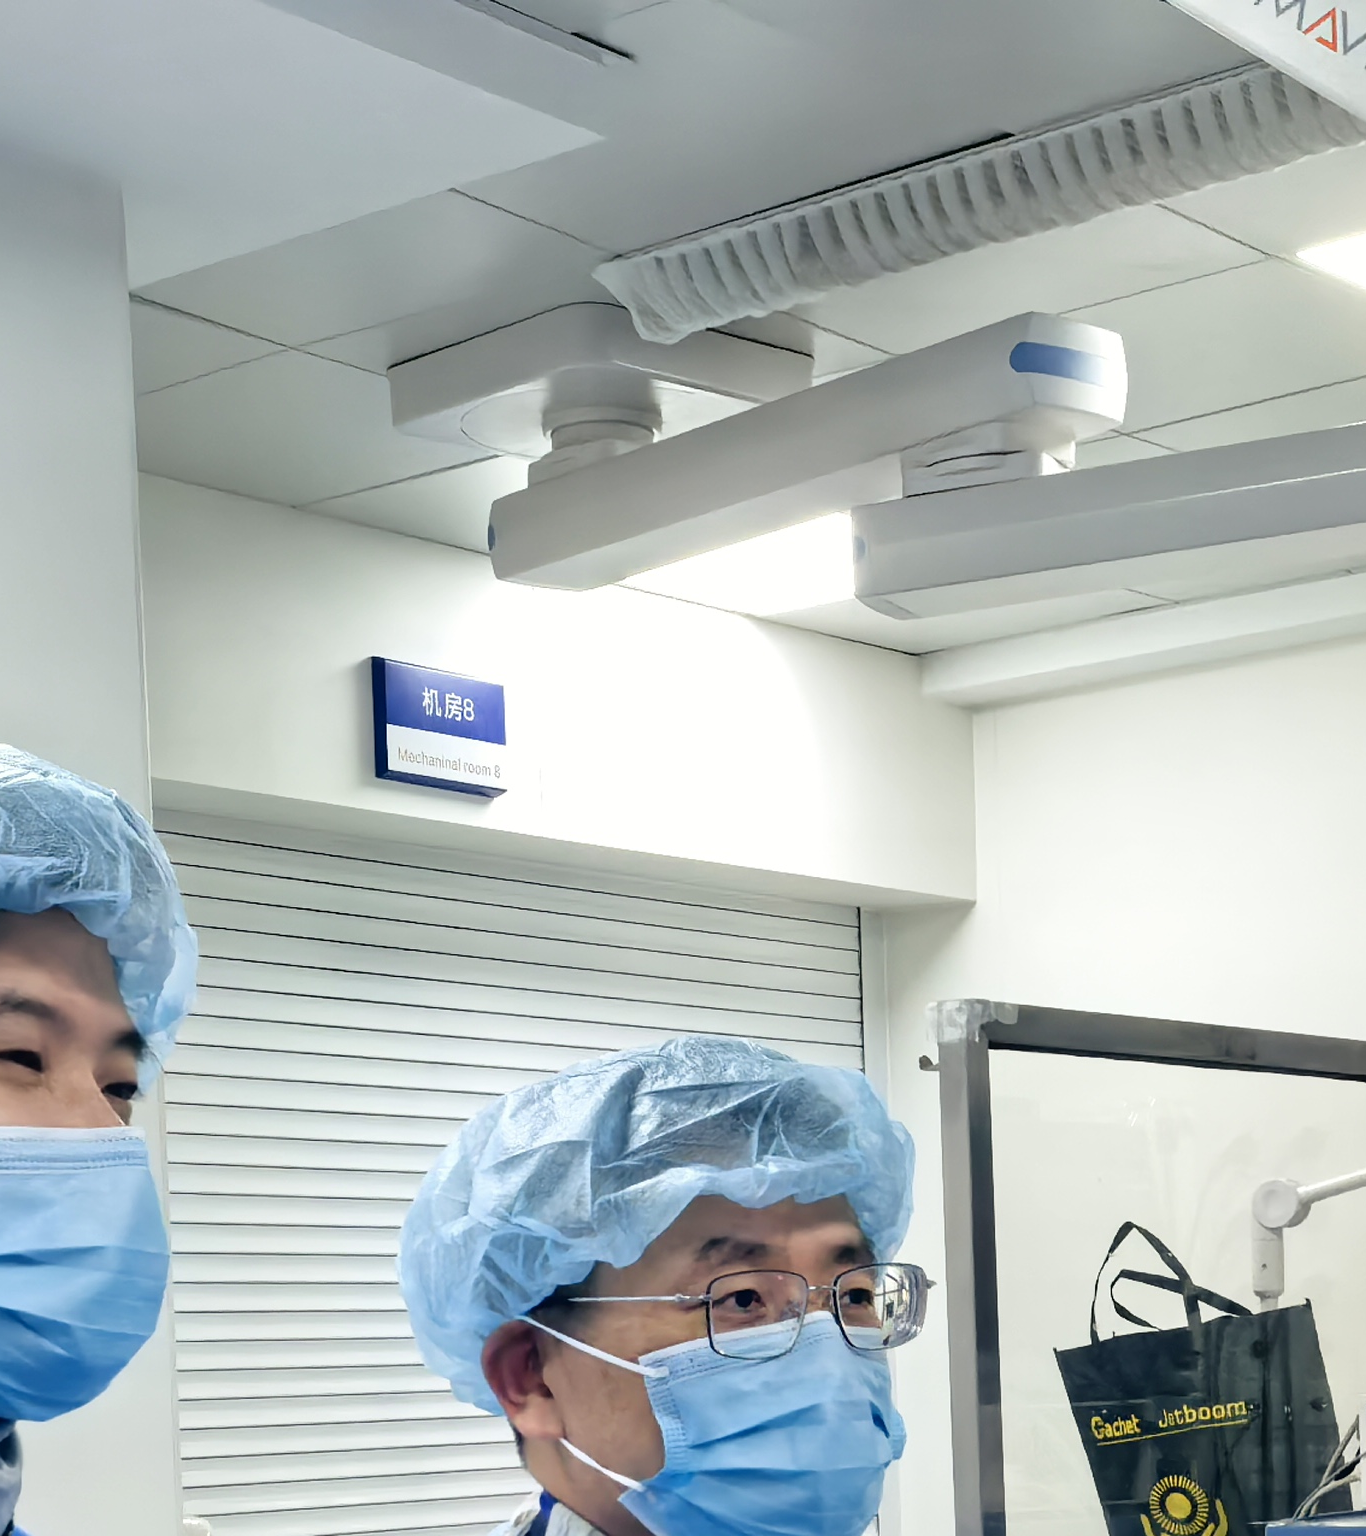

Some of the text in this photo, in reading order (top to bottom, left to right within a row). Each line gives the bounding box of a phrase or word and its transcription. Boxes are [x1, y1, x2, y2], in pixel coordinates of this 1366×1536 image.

[422, 686, 475, 722] 机房8
[463, 760, 492, 776] room
[493, 764, 501, 779] 8
